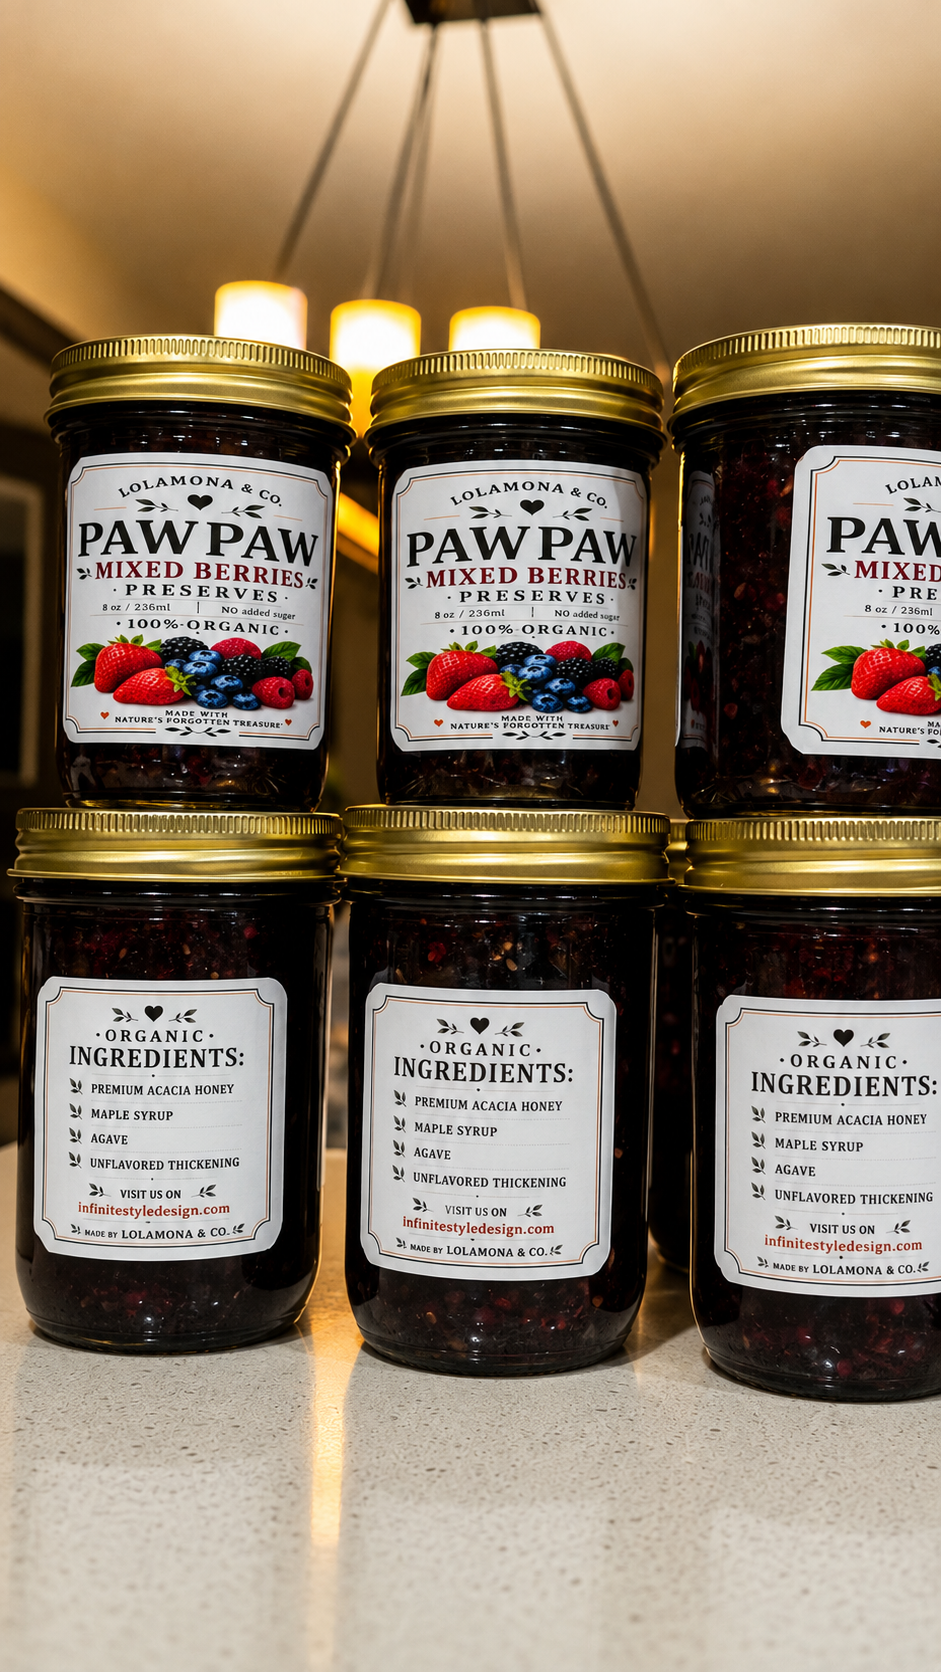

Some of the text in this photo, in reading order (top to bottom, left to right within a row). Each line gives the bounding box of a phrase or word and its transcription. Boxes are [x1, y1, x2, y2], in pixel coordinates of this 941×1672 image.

[118, 476, 282, 507] LOLAMONA & CO.
[450, 481, 607, 509] LOLAMONA & CO.
[78, 520, 319, 567] PAW PAW
[407, 526, 636, 568] PAW PAW
[95, 561, 303, 589] MIXED BERRIES
[426, 567, 626, 589] MIXED BERRIES
[854, 560, 941, 582] MIXED
[126, 584, 277, 603] PRESERVES
[459, 590, 605, 604] PRESERVES
[135, 603, 170, 611] 236ml
[222, 606, 238, 614] NO
[242, 608, 270, 617] added
[459, 610, 464, 618] /
[469, 609, 505, 617] 236ml
[892, 606, 897, 614] /
[901, 607, 932, 616] 236ml
[879, 726, 941, 736] NATURE'S FO
[105, 1029, 203, 1042] ORGANIC
[430, 1041, 530, 1056] ORGANIC
[69, 1046, 244, 1068] INGREDIENTS:
[790, 1054, 896, 1069] ORGANIC
[394, 1056, 573, 1083] INGREDIENTS:
[92, 1084, 234, 1095] PREMIUM ACACIA HONEY
[751, 1071, 937, 1097] INGREDIENTS:
[415, 1096, 562, 1112] PREMIUM ACACIA HONEY
[91, 1108, 173, 1121] MAPLE SYRUP
[775, 1112, 927, 1126] PREMIUM ACACIA HONEY
[415, 1122, 497, 1137] MAPLE SYRUP
[91, 1133, 128, 1145] AGAVE
[775, 1138, 863, 1152] MAPLE SYRUP
[414, 1147, 451, 1160] AGAVE
[90, 1157, 239, 1170] UNFLAVORED THICKENING
[775, 1164, 816, 1177] AGAVE
[414, 1172, 566, 1188] UNFLAVORED THICKENING
[120, 1189, 181, 1199] VISIT US ON
[775, 1189, 933, 1204] UNFLAVORED THICKENING
[79, 1202, 230, 1219] infinitestyledesign.com
[445, 1205, 507, 1217] VISIT US ON
[85, 1229, 105, 1237] MADE
[122, 1230, 193, 1239] LOLAMONA
[197, 1229, 206, 1238] &
[210, 1227, 230, 1237] CO.
[403, 1216, 554, 1237] infinitestyledesign.com
[810, 1223, 875, 1234] VISIT US ON
[410, 1244, 430, 1253] MADE
[447, 1246, 513, 1257] LOLAMONA
[517, 1248, 525, 1257] &
[529, 1247, 547, 1256] CO.
[765, 1234, 922, 1255] infinitestyledesign.com
[773, 1263, 796, 1271] MADE
[813, 1264, 882, 1275] LOLAMONA
[886, 1266, 894, 1275] &
[898, 1264, 916, 1274] CO.
